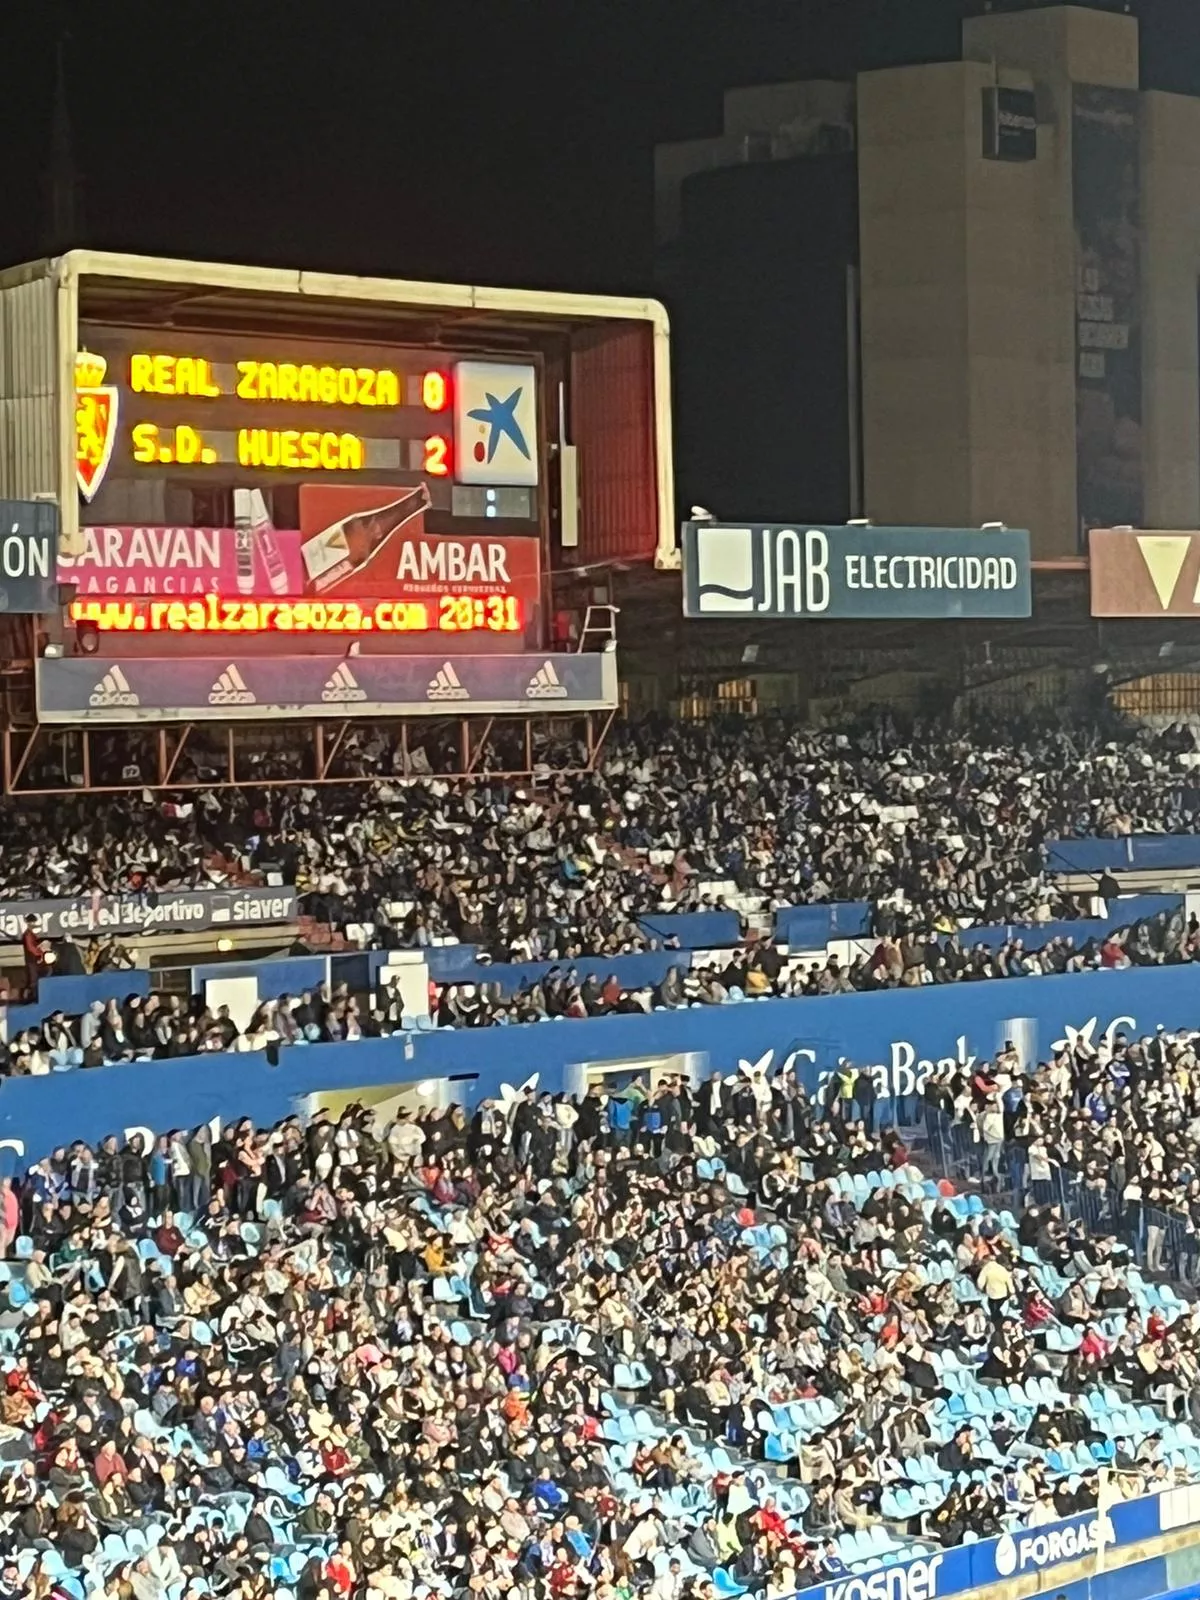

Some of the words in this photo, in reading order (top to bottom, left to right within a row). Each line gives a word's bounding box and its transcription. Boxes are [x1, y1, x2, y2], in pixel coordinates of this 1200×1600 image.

[131, 354, 220, 397] REAL
[236, 361, 399, 406] ZARAGOZA
[423, 371, 444, 411] 0
[132, 423, 217, 464] S.D.
[238, 429, 362, 470] HUESCA
[425, 435, 448, 475] 2
[3, 523, 49, 578] ÓN
[396, 541, 512, 583] AMBAR
[758, 529, 830, 612] JAB
[845, 555, 1017, 590] ELECTRICIDAD
[56, 575, 220, 594] RAGANCIAS
[439, 596, 520, 631] 20:31
[233, 894, 293, 921] siaver
